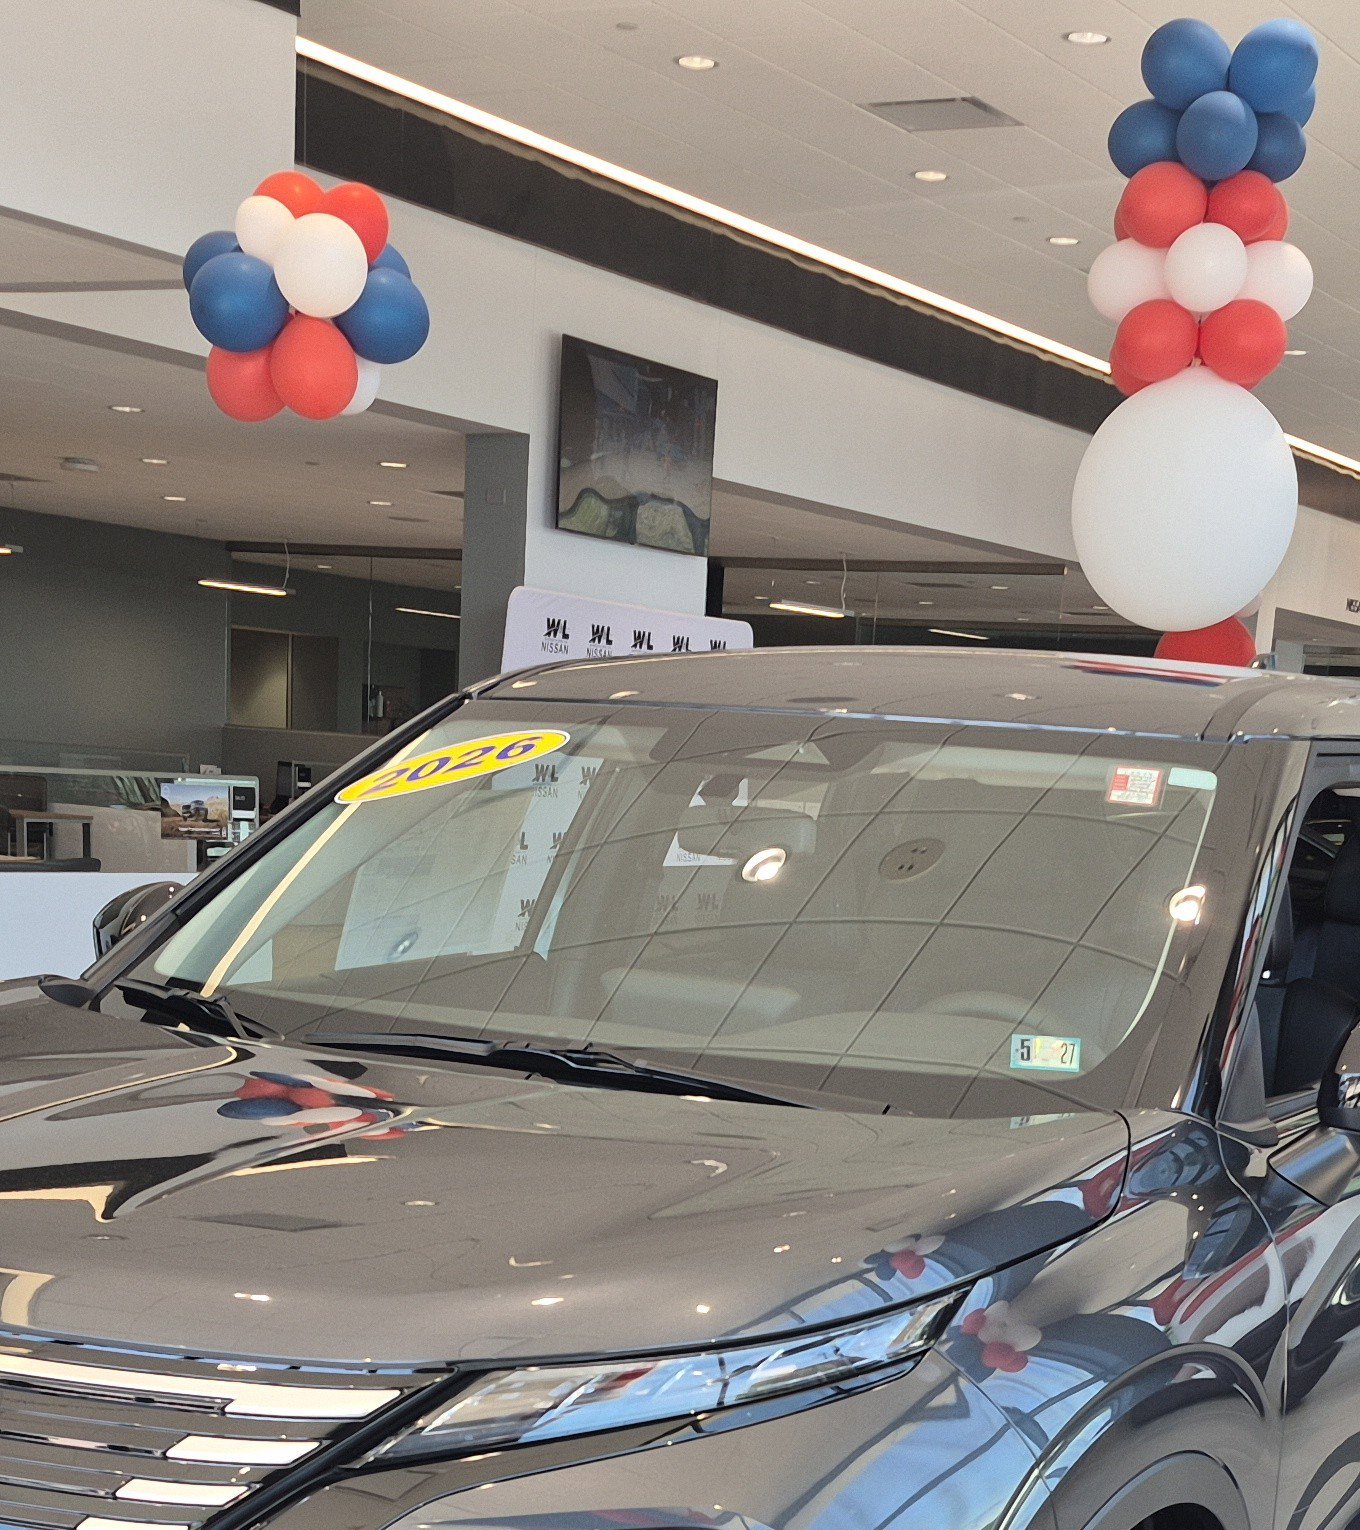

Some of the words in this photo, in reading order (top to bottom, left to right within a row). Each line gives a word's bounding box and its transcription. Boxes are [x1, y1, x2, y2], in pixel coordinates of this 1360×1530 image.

[541, 641, 569, 655] NISSAN
[357, 736, 544, 797] 2026
[1020, 1038, 1031, 1061] 5
[1061, 1042, 1076, 1066] 27
